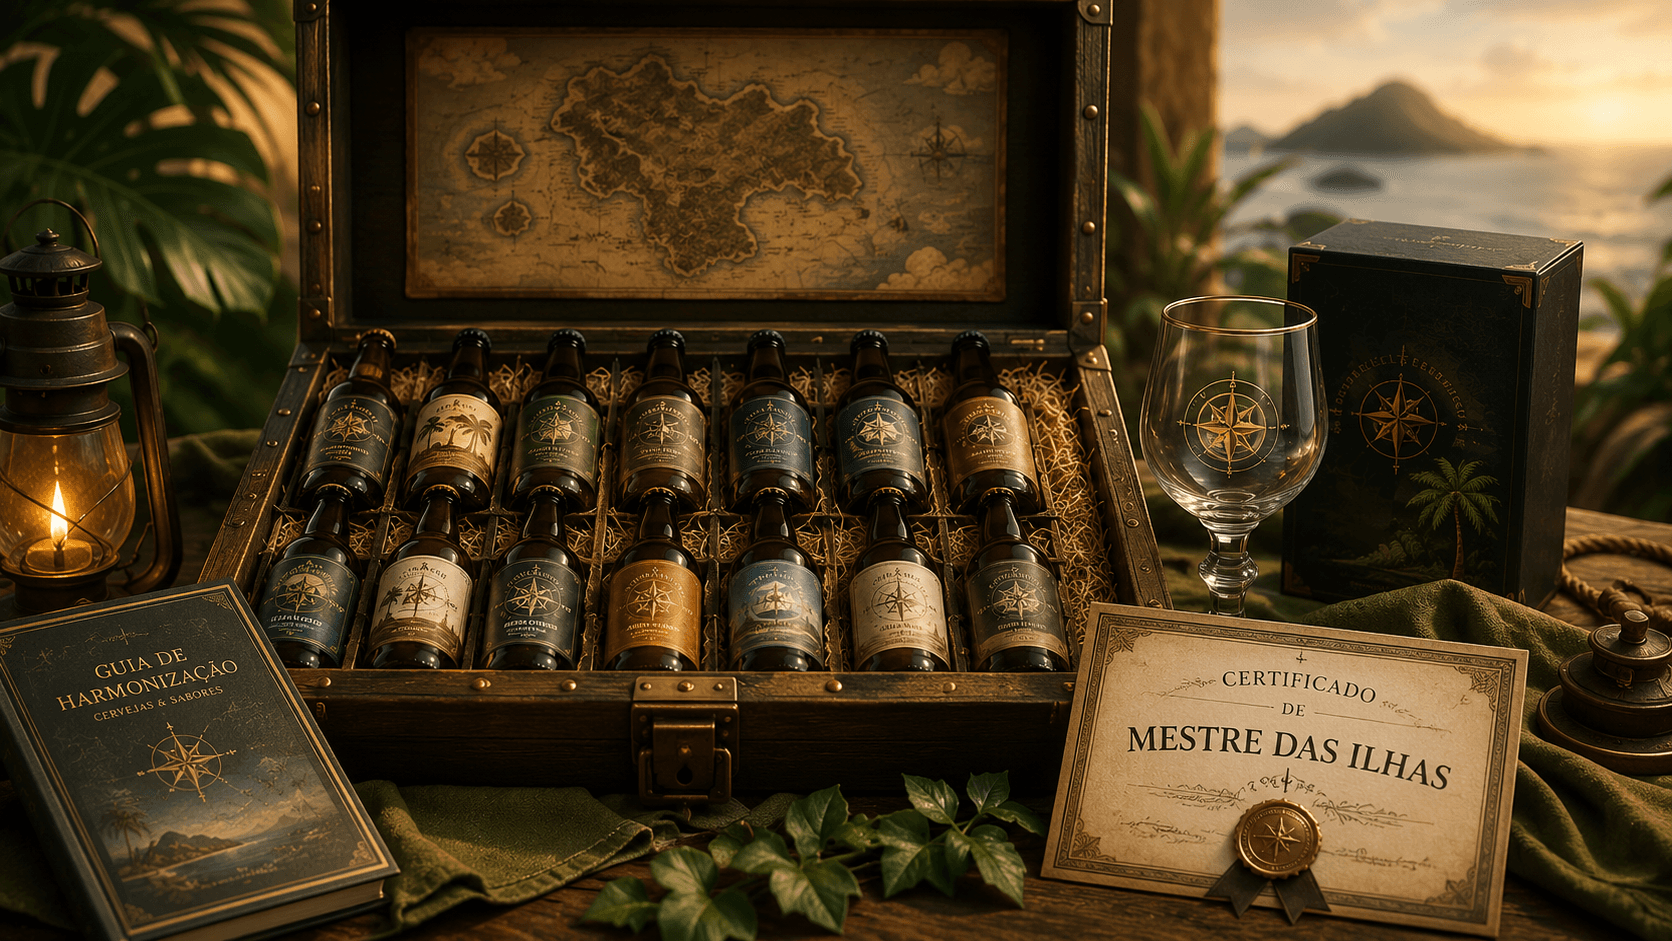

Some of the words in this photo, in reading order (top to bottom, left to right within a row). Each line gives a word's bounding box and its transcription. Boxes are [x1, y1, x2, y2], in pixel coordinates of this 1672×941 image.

[94, 657, 153, 680] GUIA
[155, 648, 188, 666] DE
[56, 659, 239, 712] HARMONIZAÇÃO
[1222, 670, 1377, 704] CERTIFICADO
[93, 700, 155, 722] CERVEJAS
[158, 698, 167, 707] &
[169, 686, 224, 704] SABORES
[1281, 701, 1306, 717] DE
[1127, 726, 1263, 755] MESTRE
[1272, 730, 1340, 765] DAS
[1347, 742, 1452, 791] ILHAS
